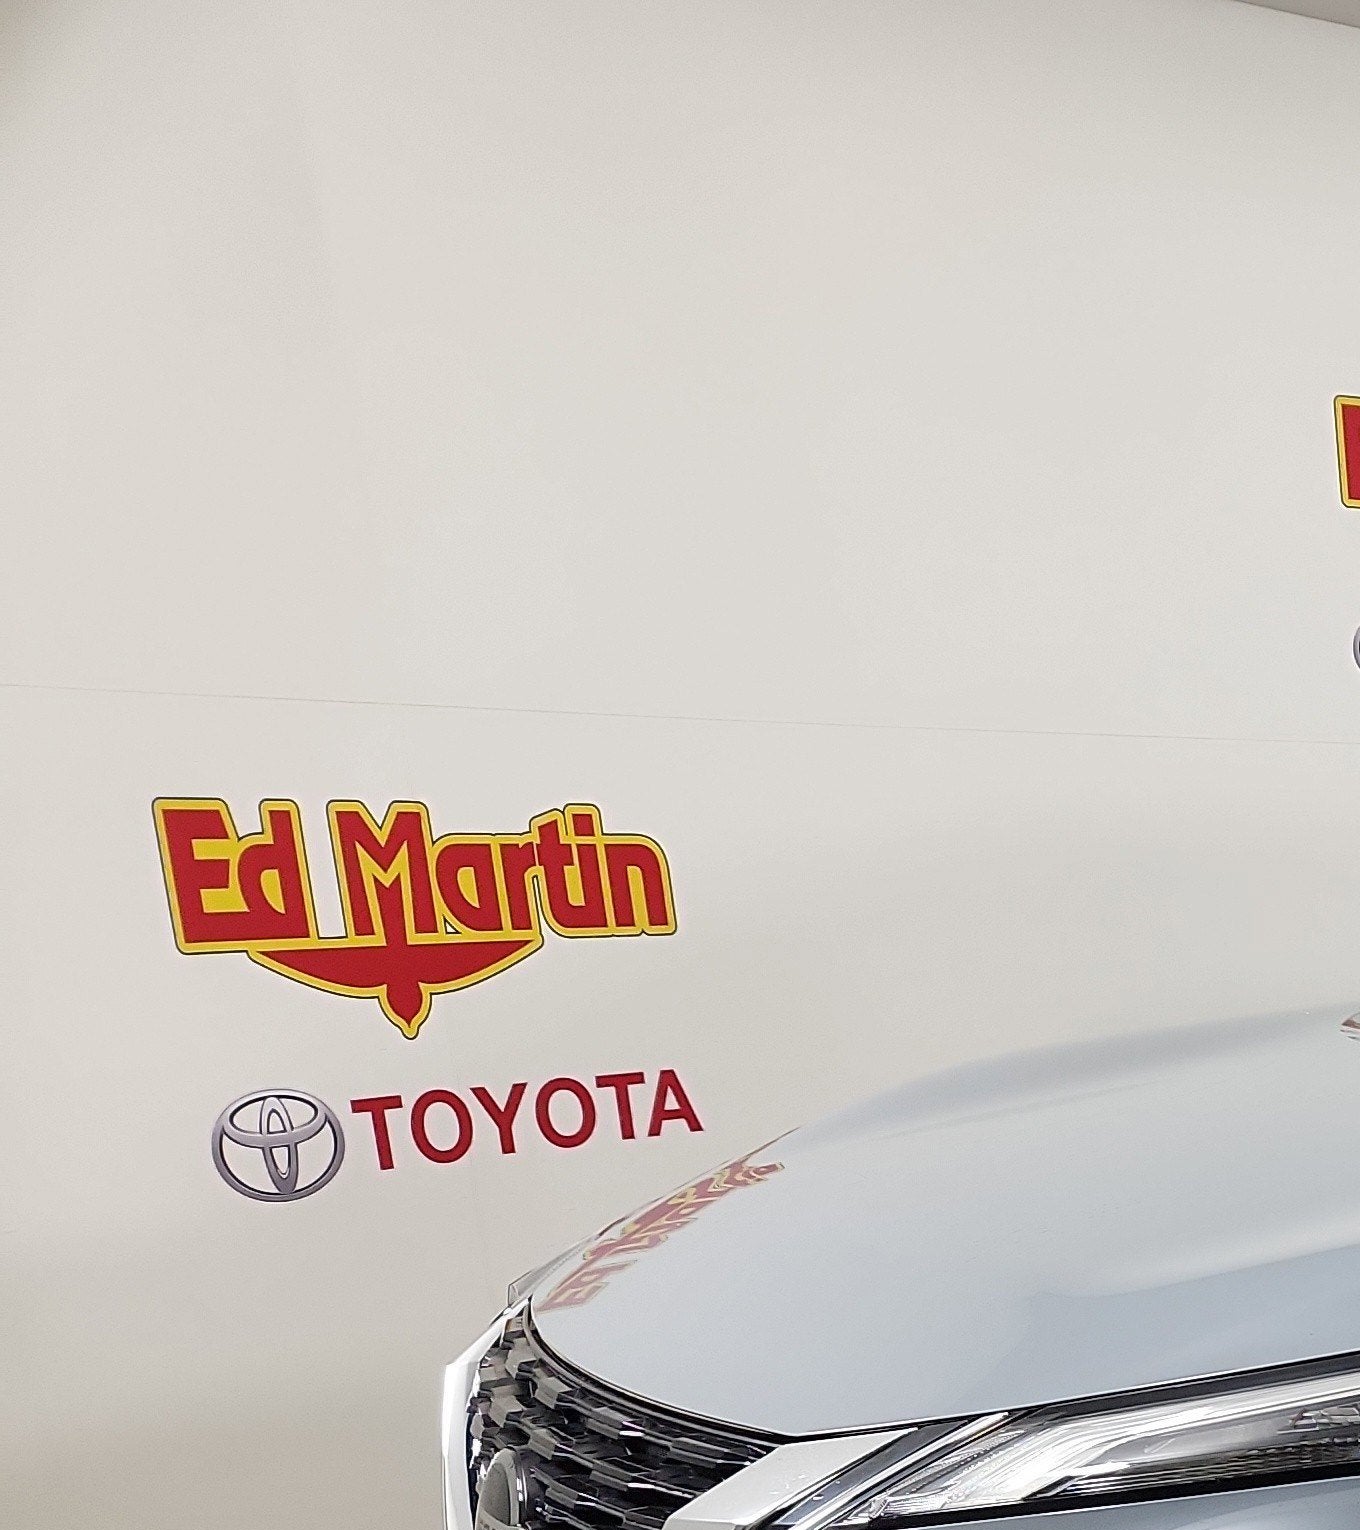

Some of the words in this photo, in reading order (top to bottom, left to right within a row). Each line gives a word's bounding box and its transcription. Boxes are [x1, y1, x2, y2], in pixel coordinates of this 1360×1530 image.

[152, 798, 319, 954] Ed
[326, 800, 677, 943] Martin
[351, 1069, 704, 1171] TOYOTA
